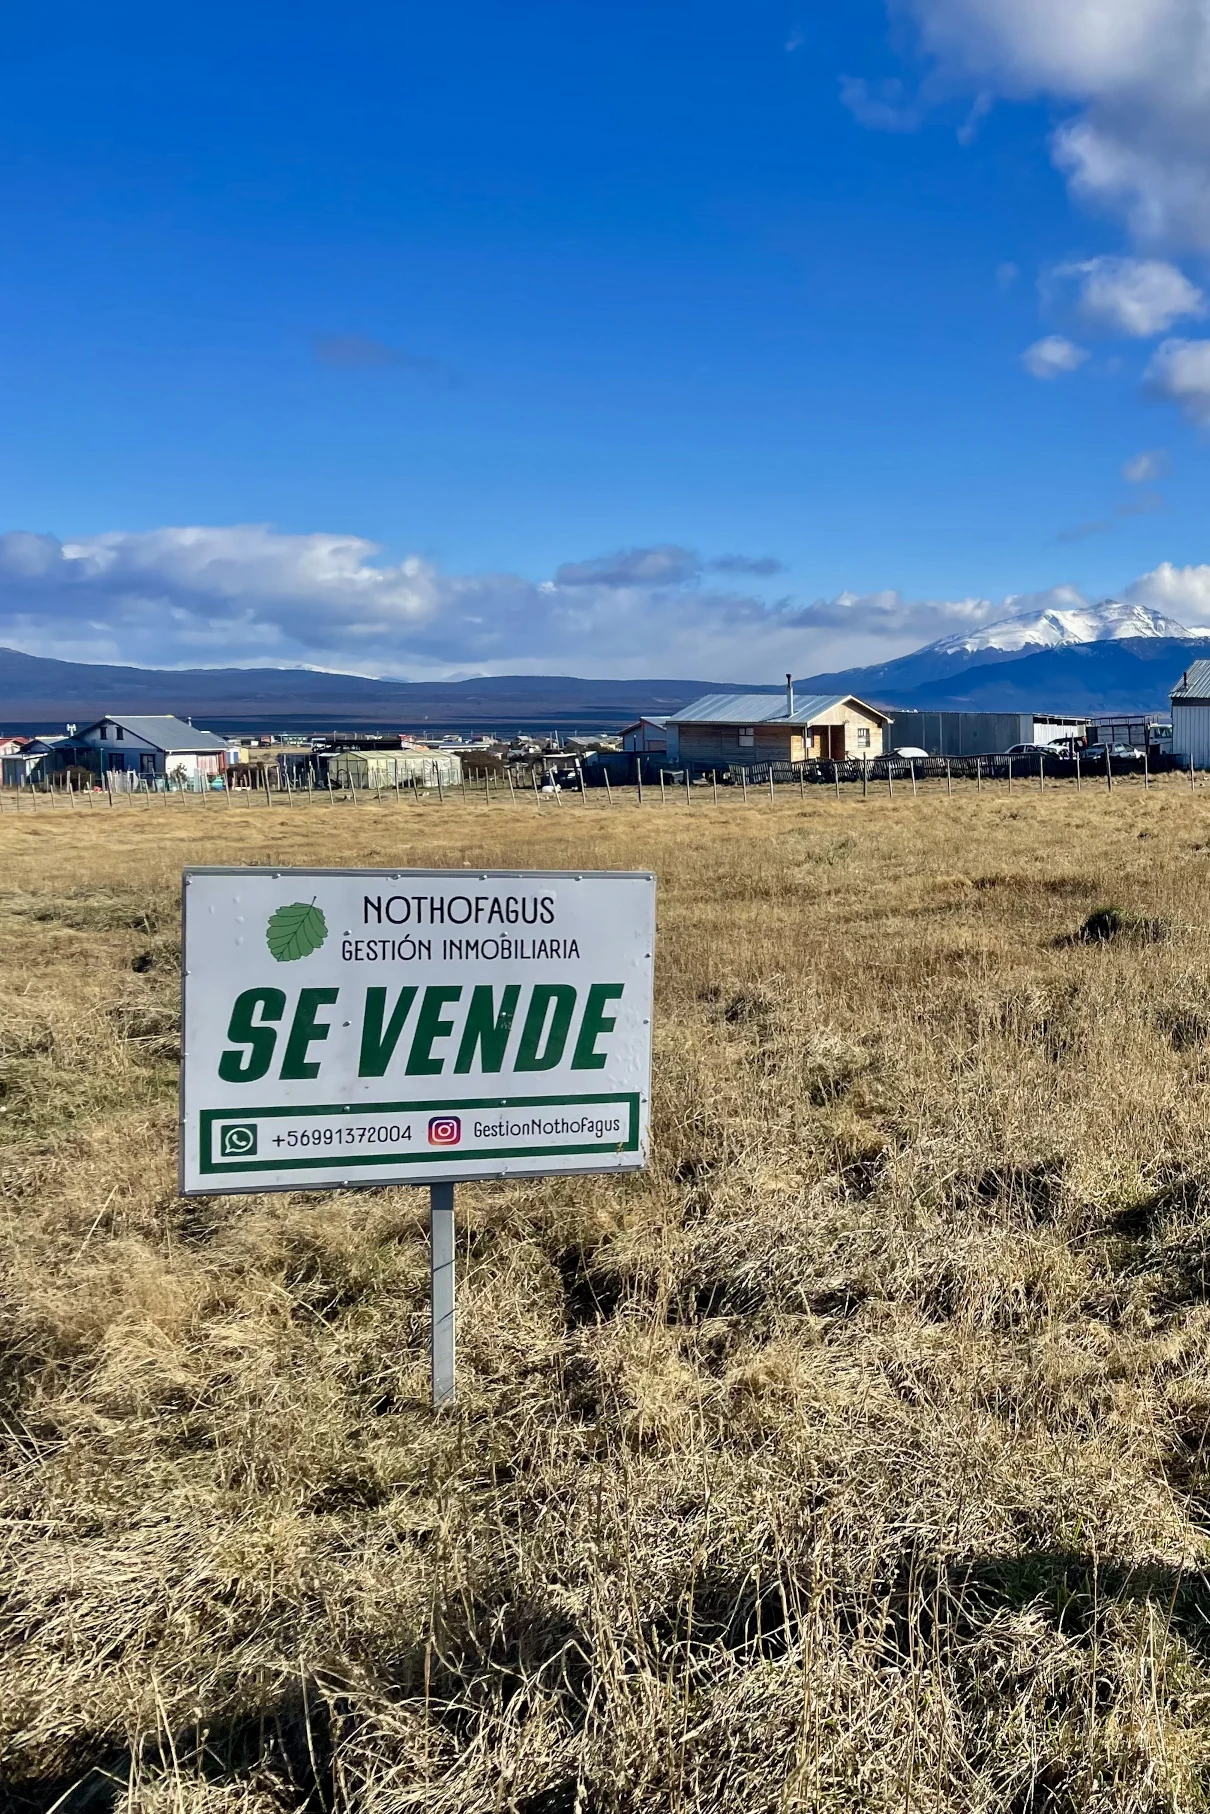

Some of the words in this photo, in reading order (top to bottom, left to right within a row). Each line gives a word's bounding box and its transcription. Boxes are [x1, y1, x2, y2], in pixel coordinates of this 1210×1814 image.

[364, 896, 555, 924] NOTHOFAGUS
[342, 934, 432, 961] GESTIÓN
[443, 938, 580, 960] INMOBILIARIA
[218, 987, 340, 1083] SE
[358, 983, 625, 1078] VENDE
[272, 1125, 412, 1147] +56991372004
